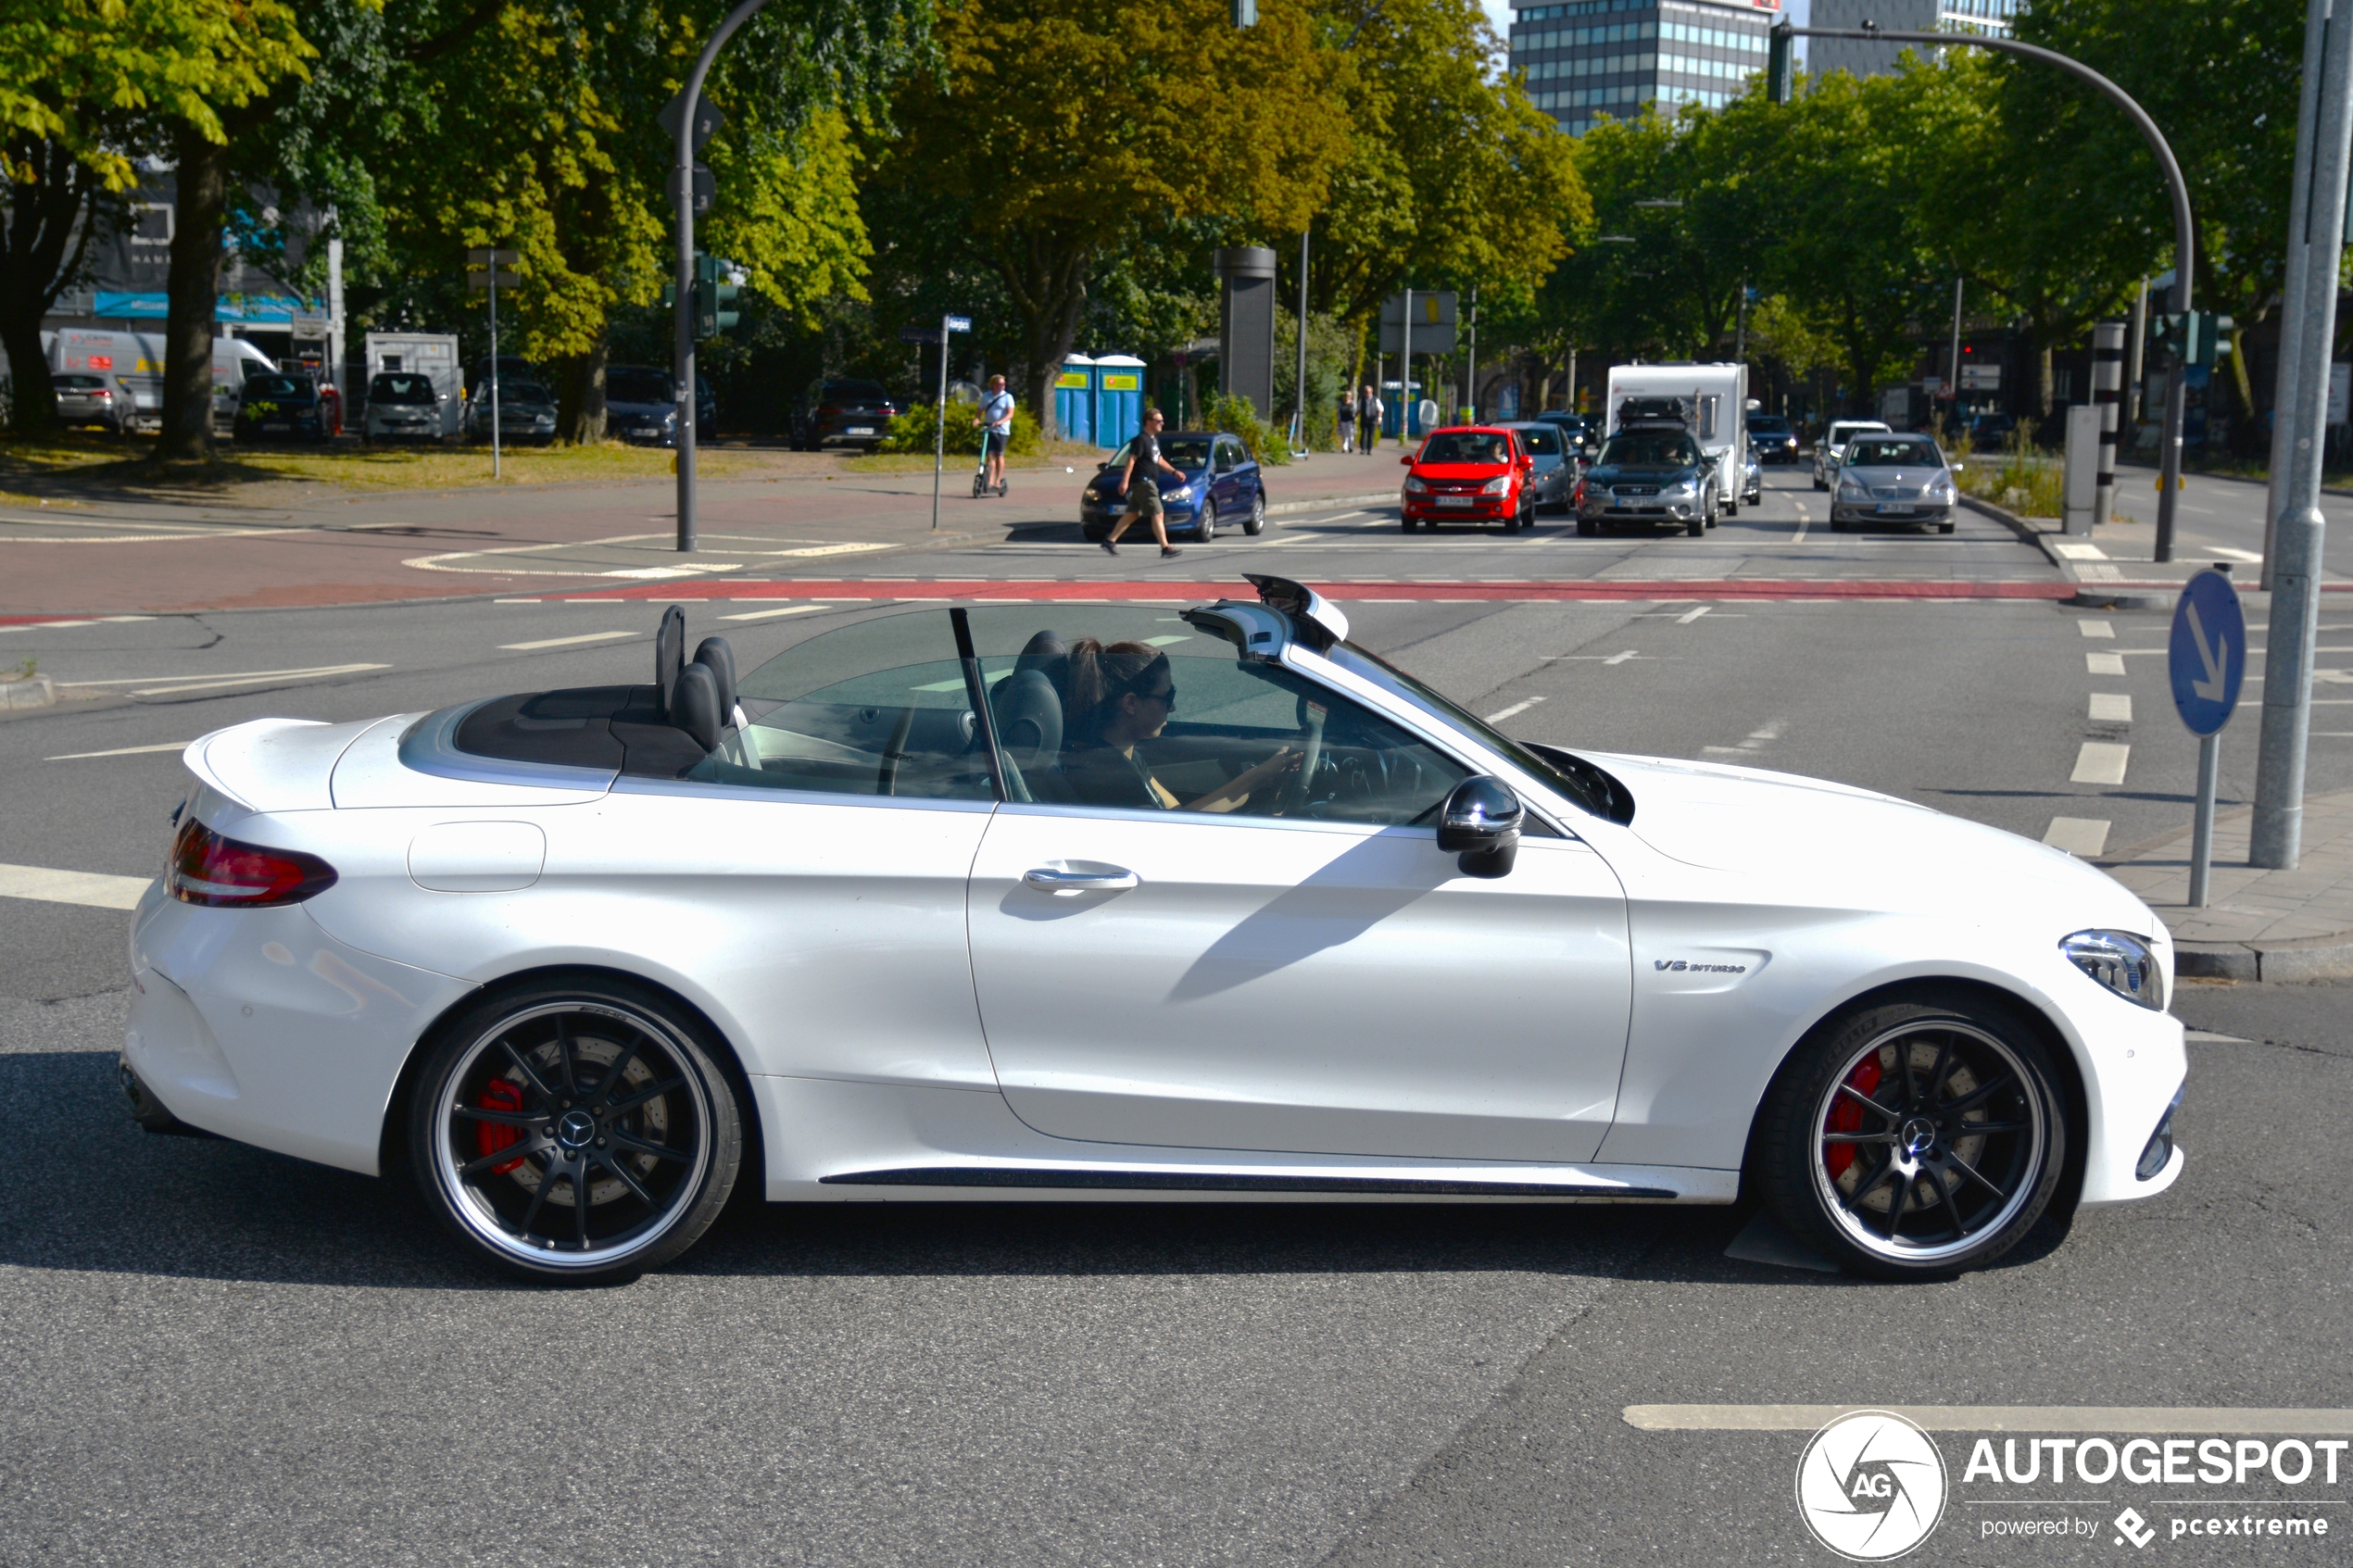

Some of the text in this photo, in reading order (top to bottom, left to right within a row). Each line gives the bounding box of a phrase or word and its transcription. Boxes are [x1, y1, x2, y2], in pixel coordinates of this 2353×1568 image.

[1689, 963, 1746, 973] BITURBO
[594, 1007, 627, 1021] AMG
[1812, 1016, 1878, 1082] MICHELIN
